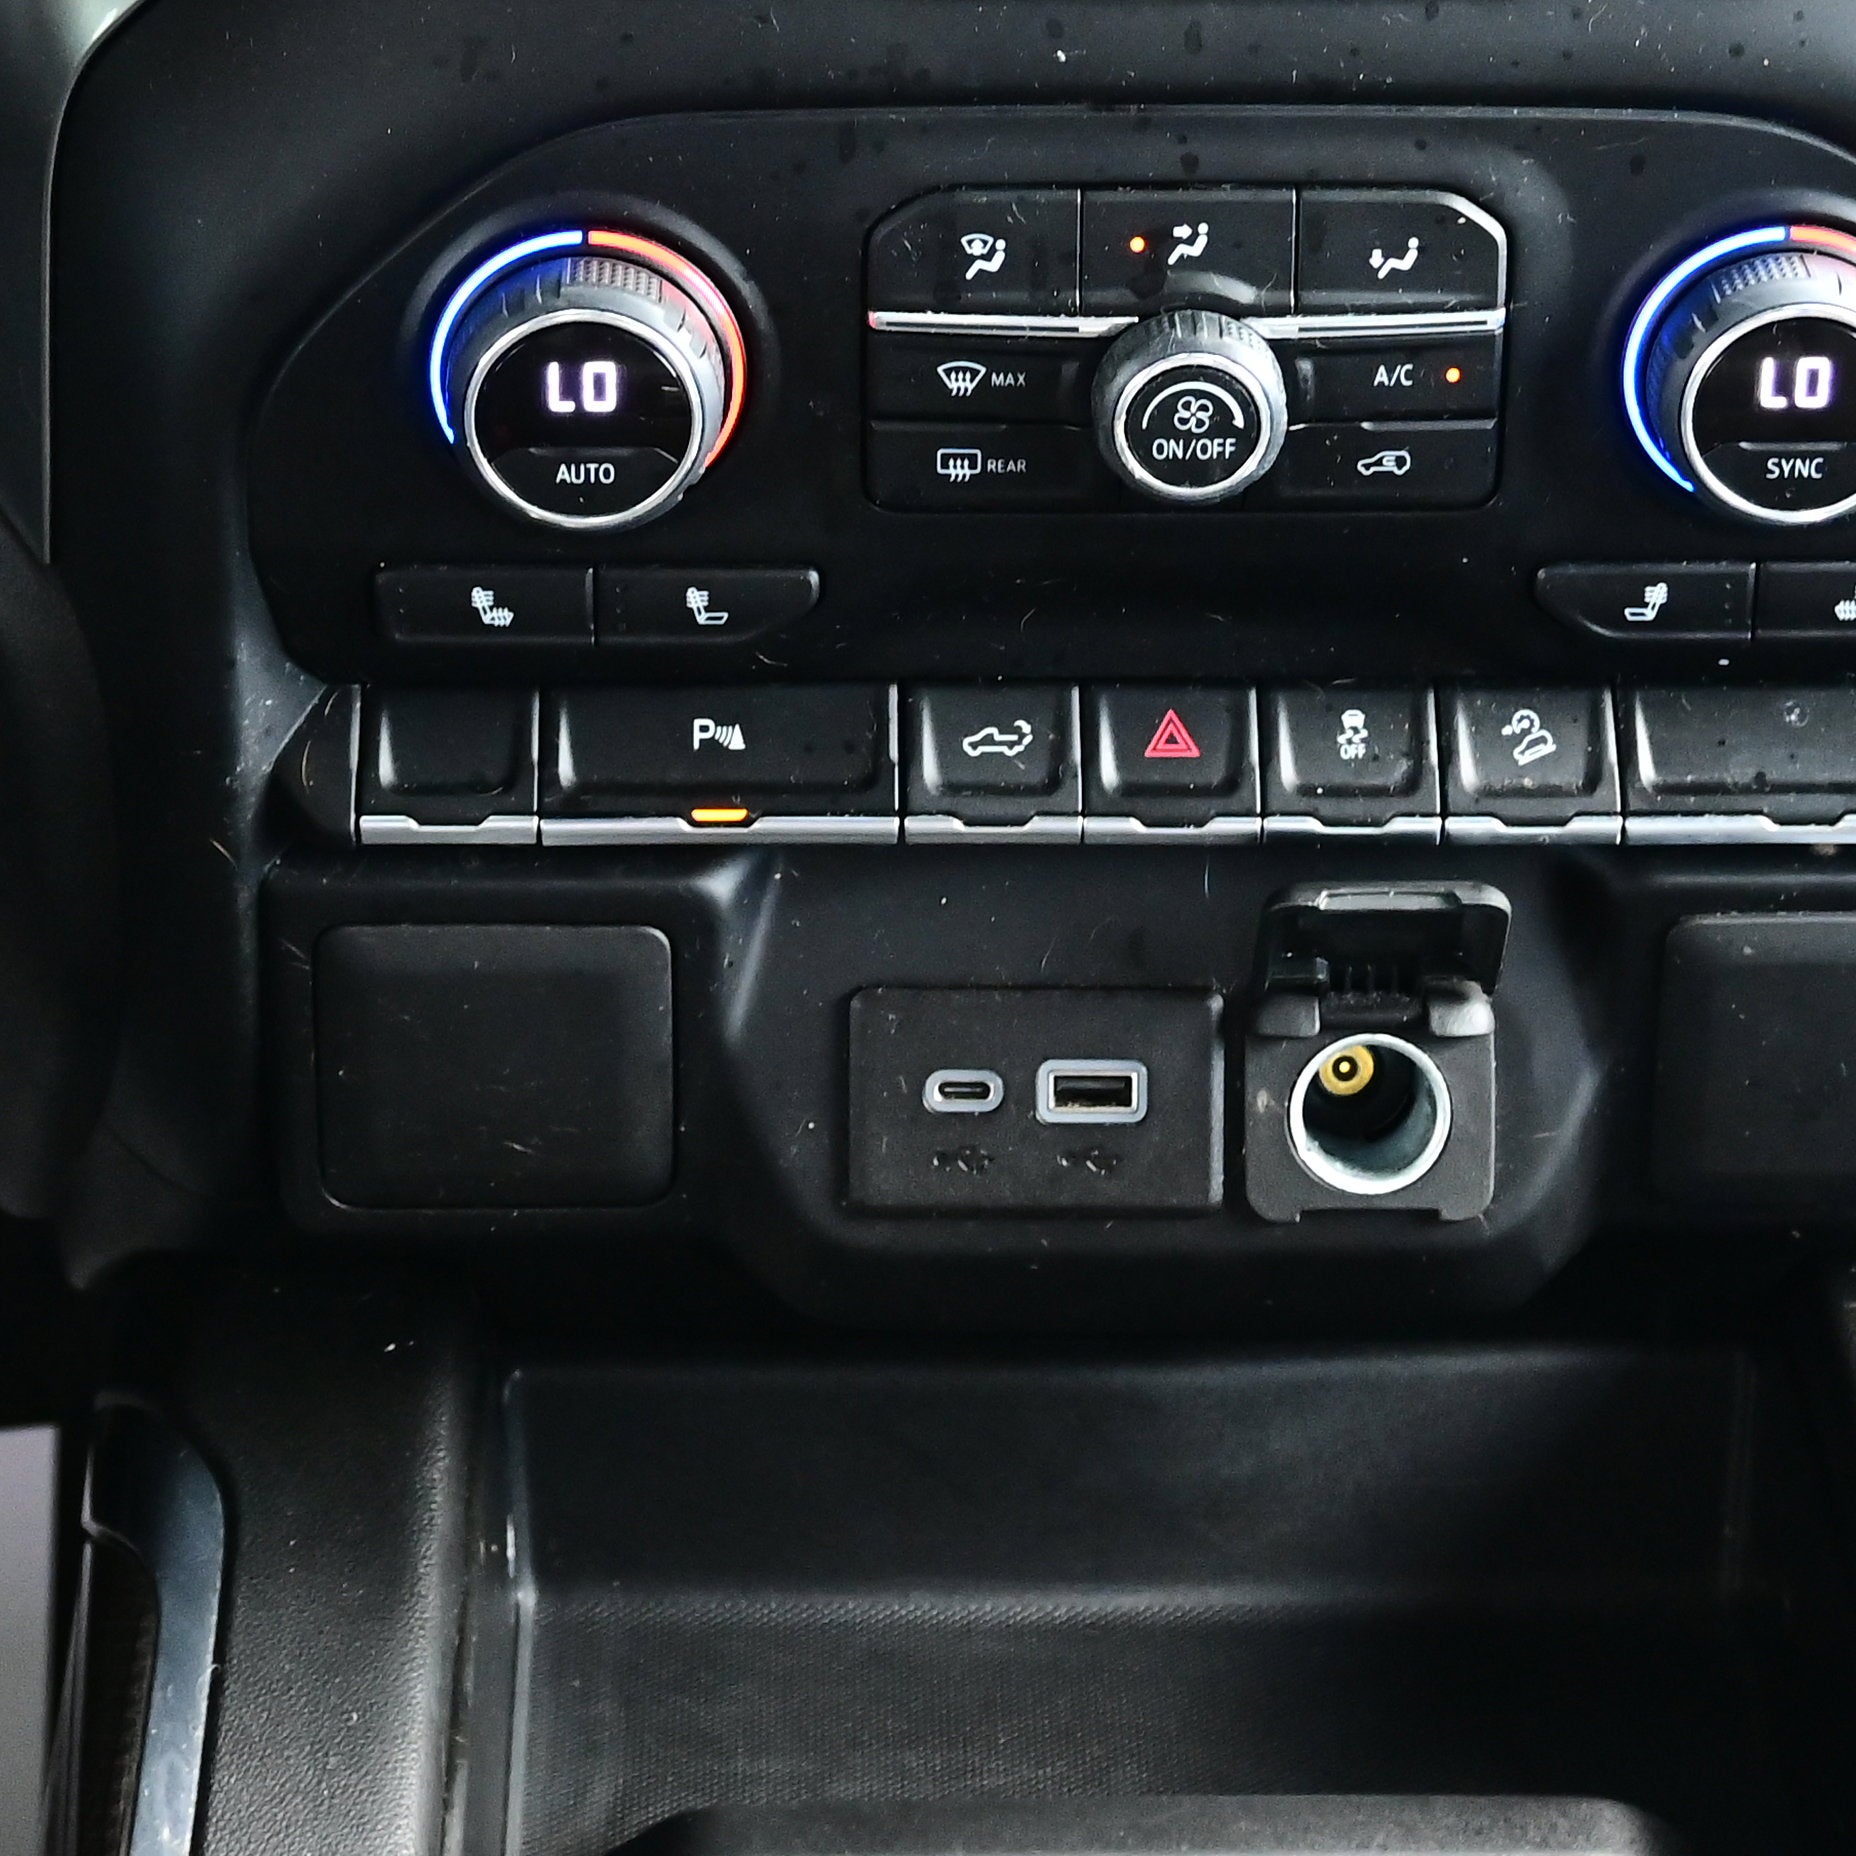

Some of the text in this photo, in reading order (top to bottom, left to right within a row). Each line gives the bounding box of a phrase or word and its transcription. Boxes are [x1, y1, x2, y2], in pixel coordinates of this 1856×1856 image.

[991, 371, 1026, 387] MAX
[1373, 363, 1414, 387] A/C
[1757, 356, 1833, 410] LO
[546, 360, 618, 413] LO
[1152, 437, 1236, 461] ON/OFF
[555, 462, 615, 484] AUTO
[987, 458, 1026, 474] REAR
[1766, 457, 1824, 479] SYNC
[1339, 743, 1366, 760] OFF
